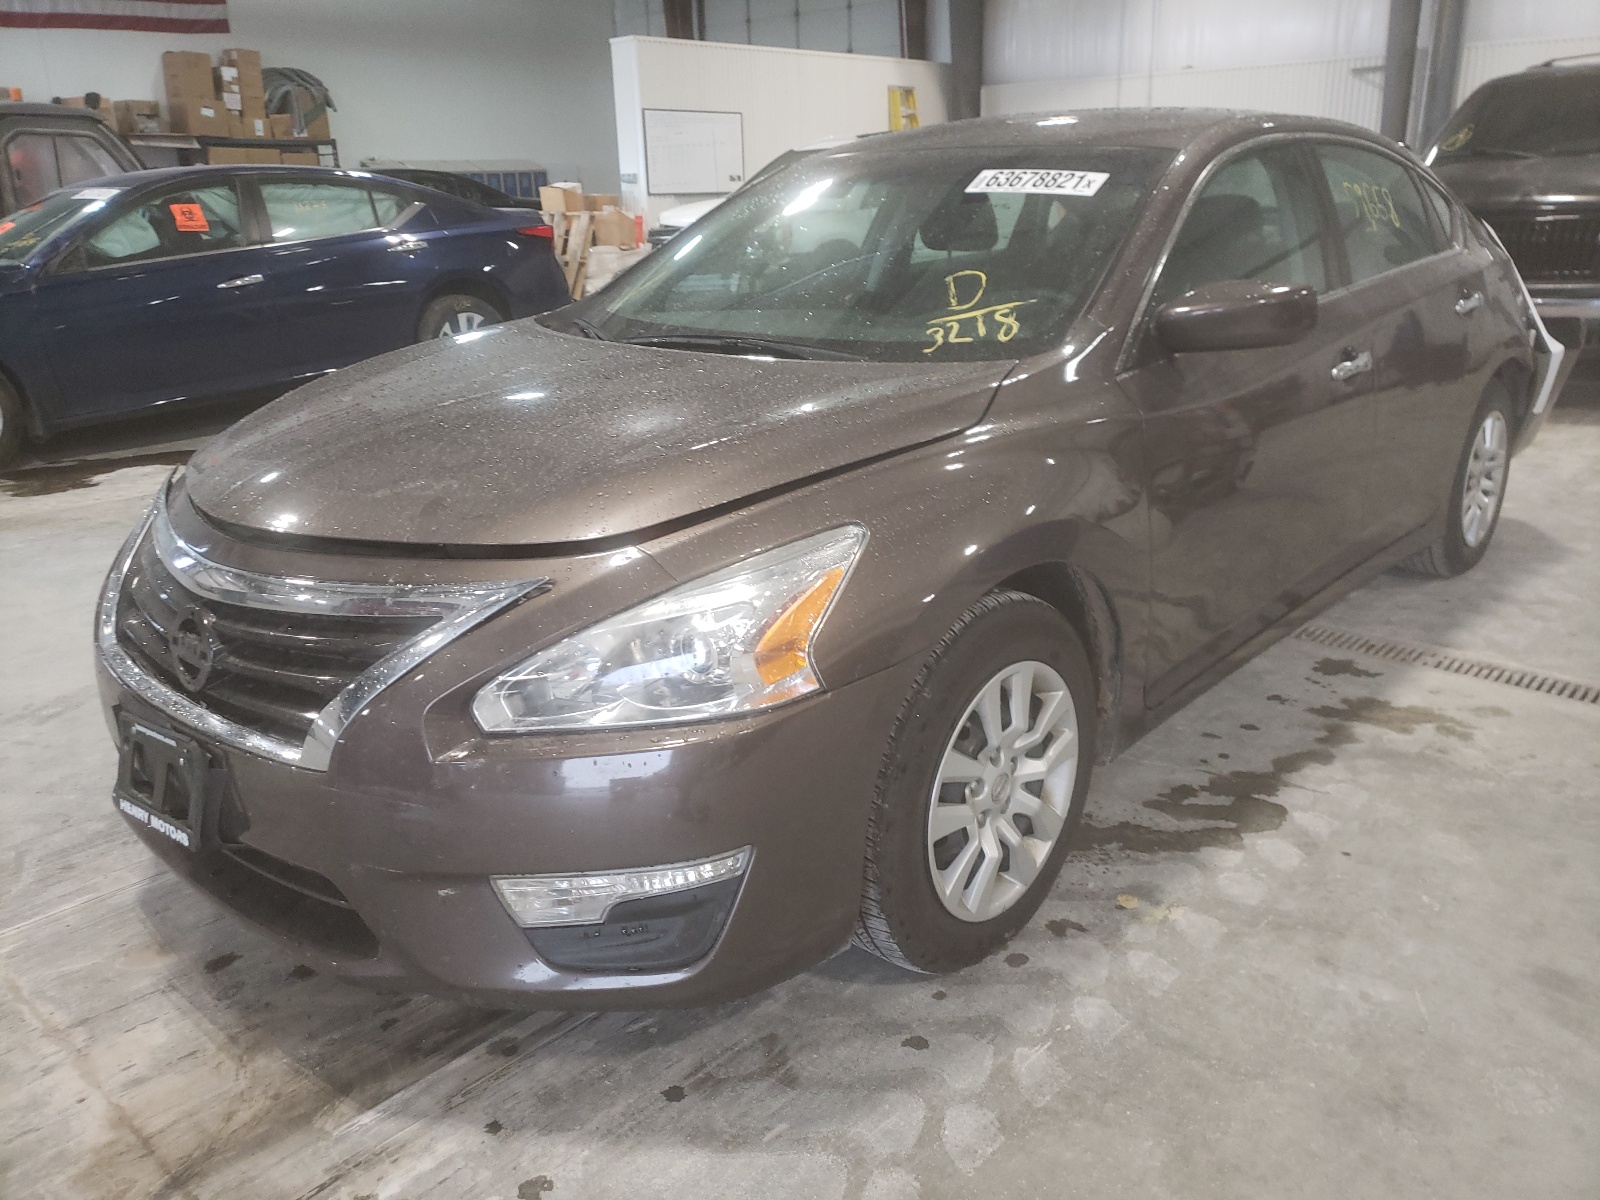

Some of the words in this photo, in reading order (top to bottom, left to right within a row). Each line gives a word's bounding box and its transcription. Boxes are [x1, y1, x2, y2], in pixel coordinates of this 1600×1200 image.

[986, 172, 1087, 189] 63678821
[945, 269, 987, 310] D
[922, 308, 1021, 354] 3218
[149, 814, 190, 847] MOTORS
